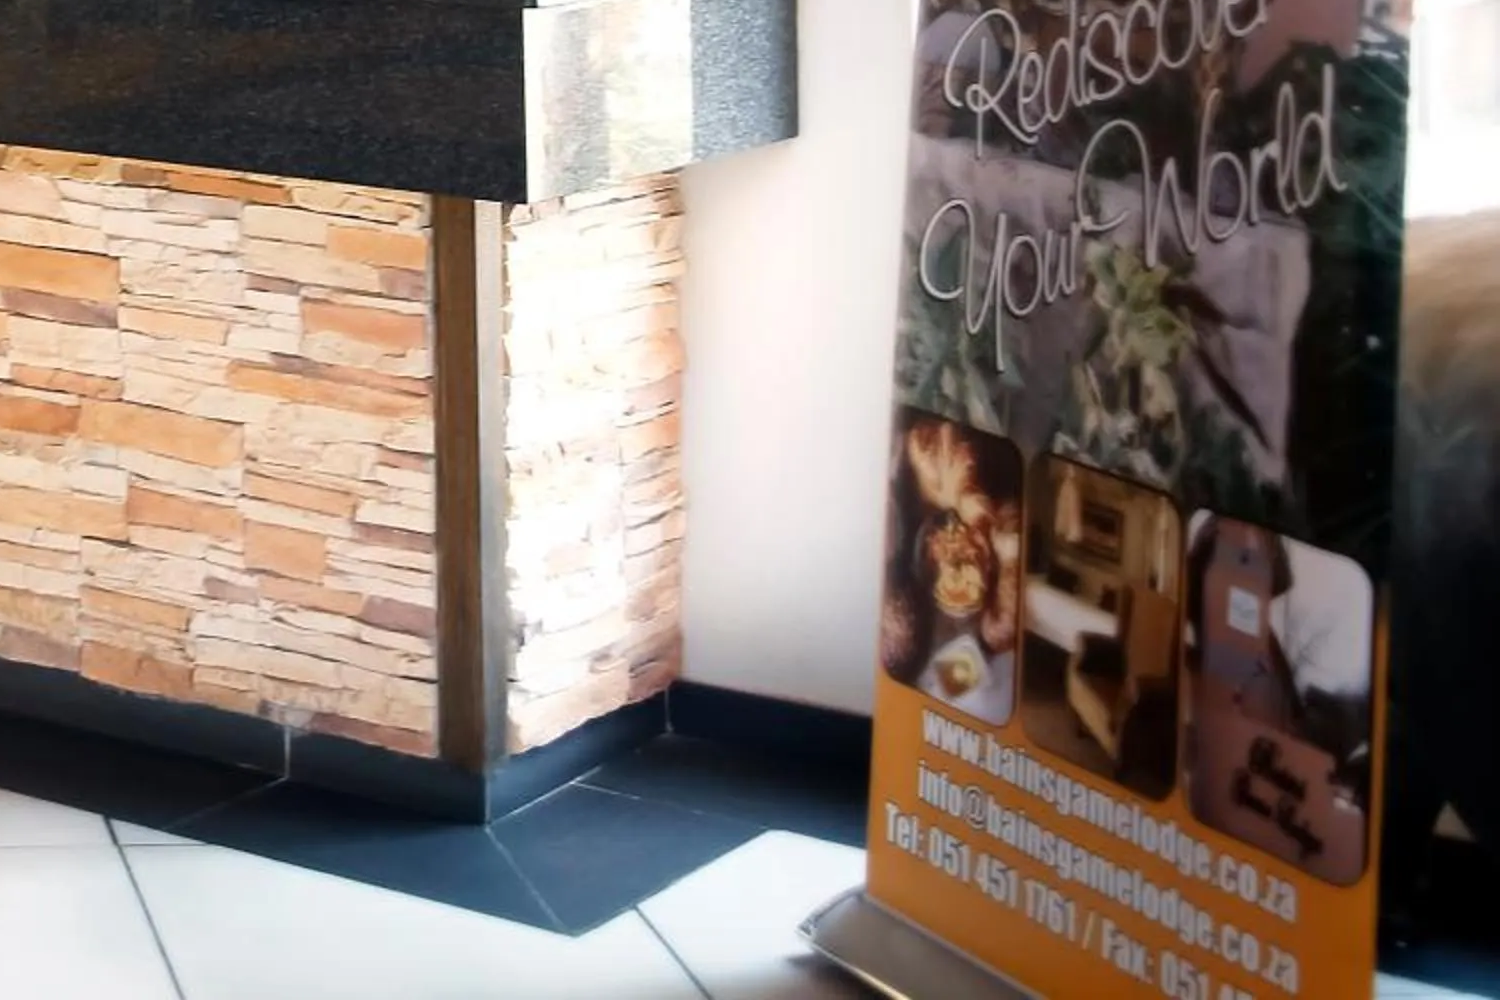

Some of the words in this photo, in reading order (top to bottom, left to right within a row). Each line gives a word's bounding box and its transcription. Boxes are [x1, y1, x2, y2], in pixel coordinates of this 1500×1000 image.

[920, 199, 1092, 373] Your
[1074, 63, 1348, 268] World
[885, 801, 925, 859] Tel:
[929, 825, 970, 883] 051
[974, 853, 1018, 909] 451
[1024, 878, 1078, 942] 1761
[1101, 917, 1155, 985] Fax:
[917, 759, 1298, 994] info@bainsgamelodge.co.za
[922, 708, 1297, 923] www.bainsgamelodge.co.za
